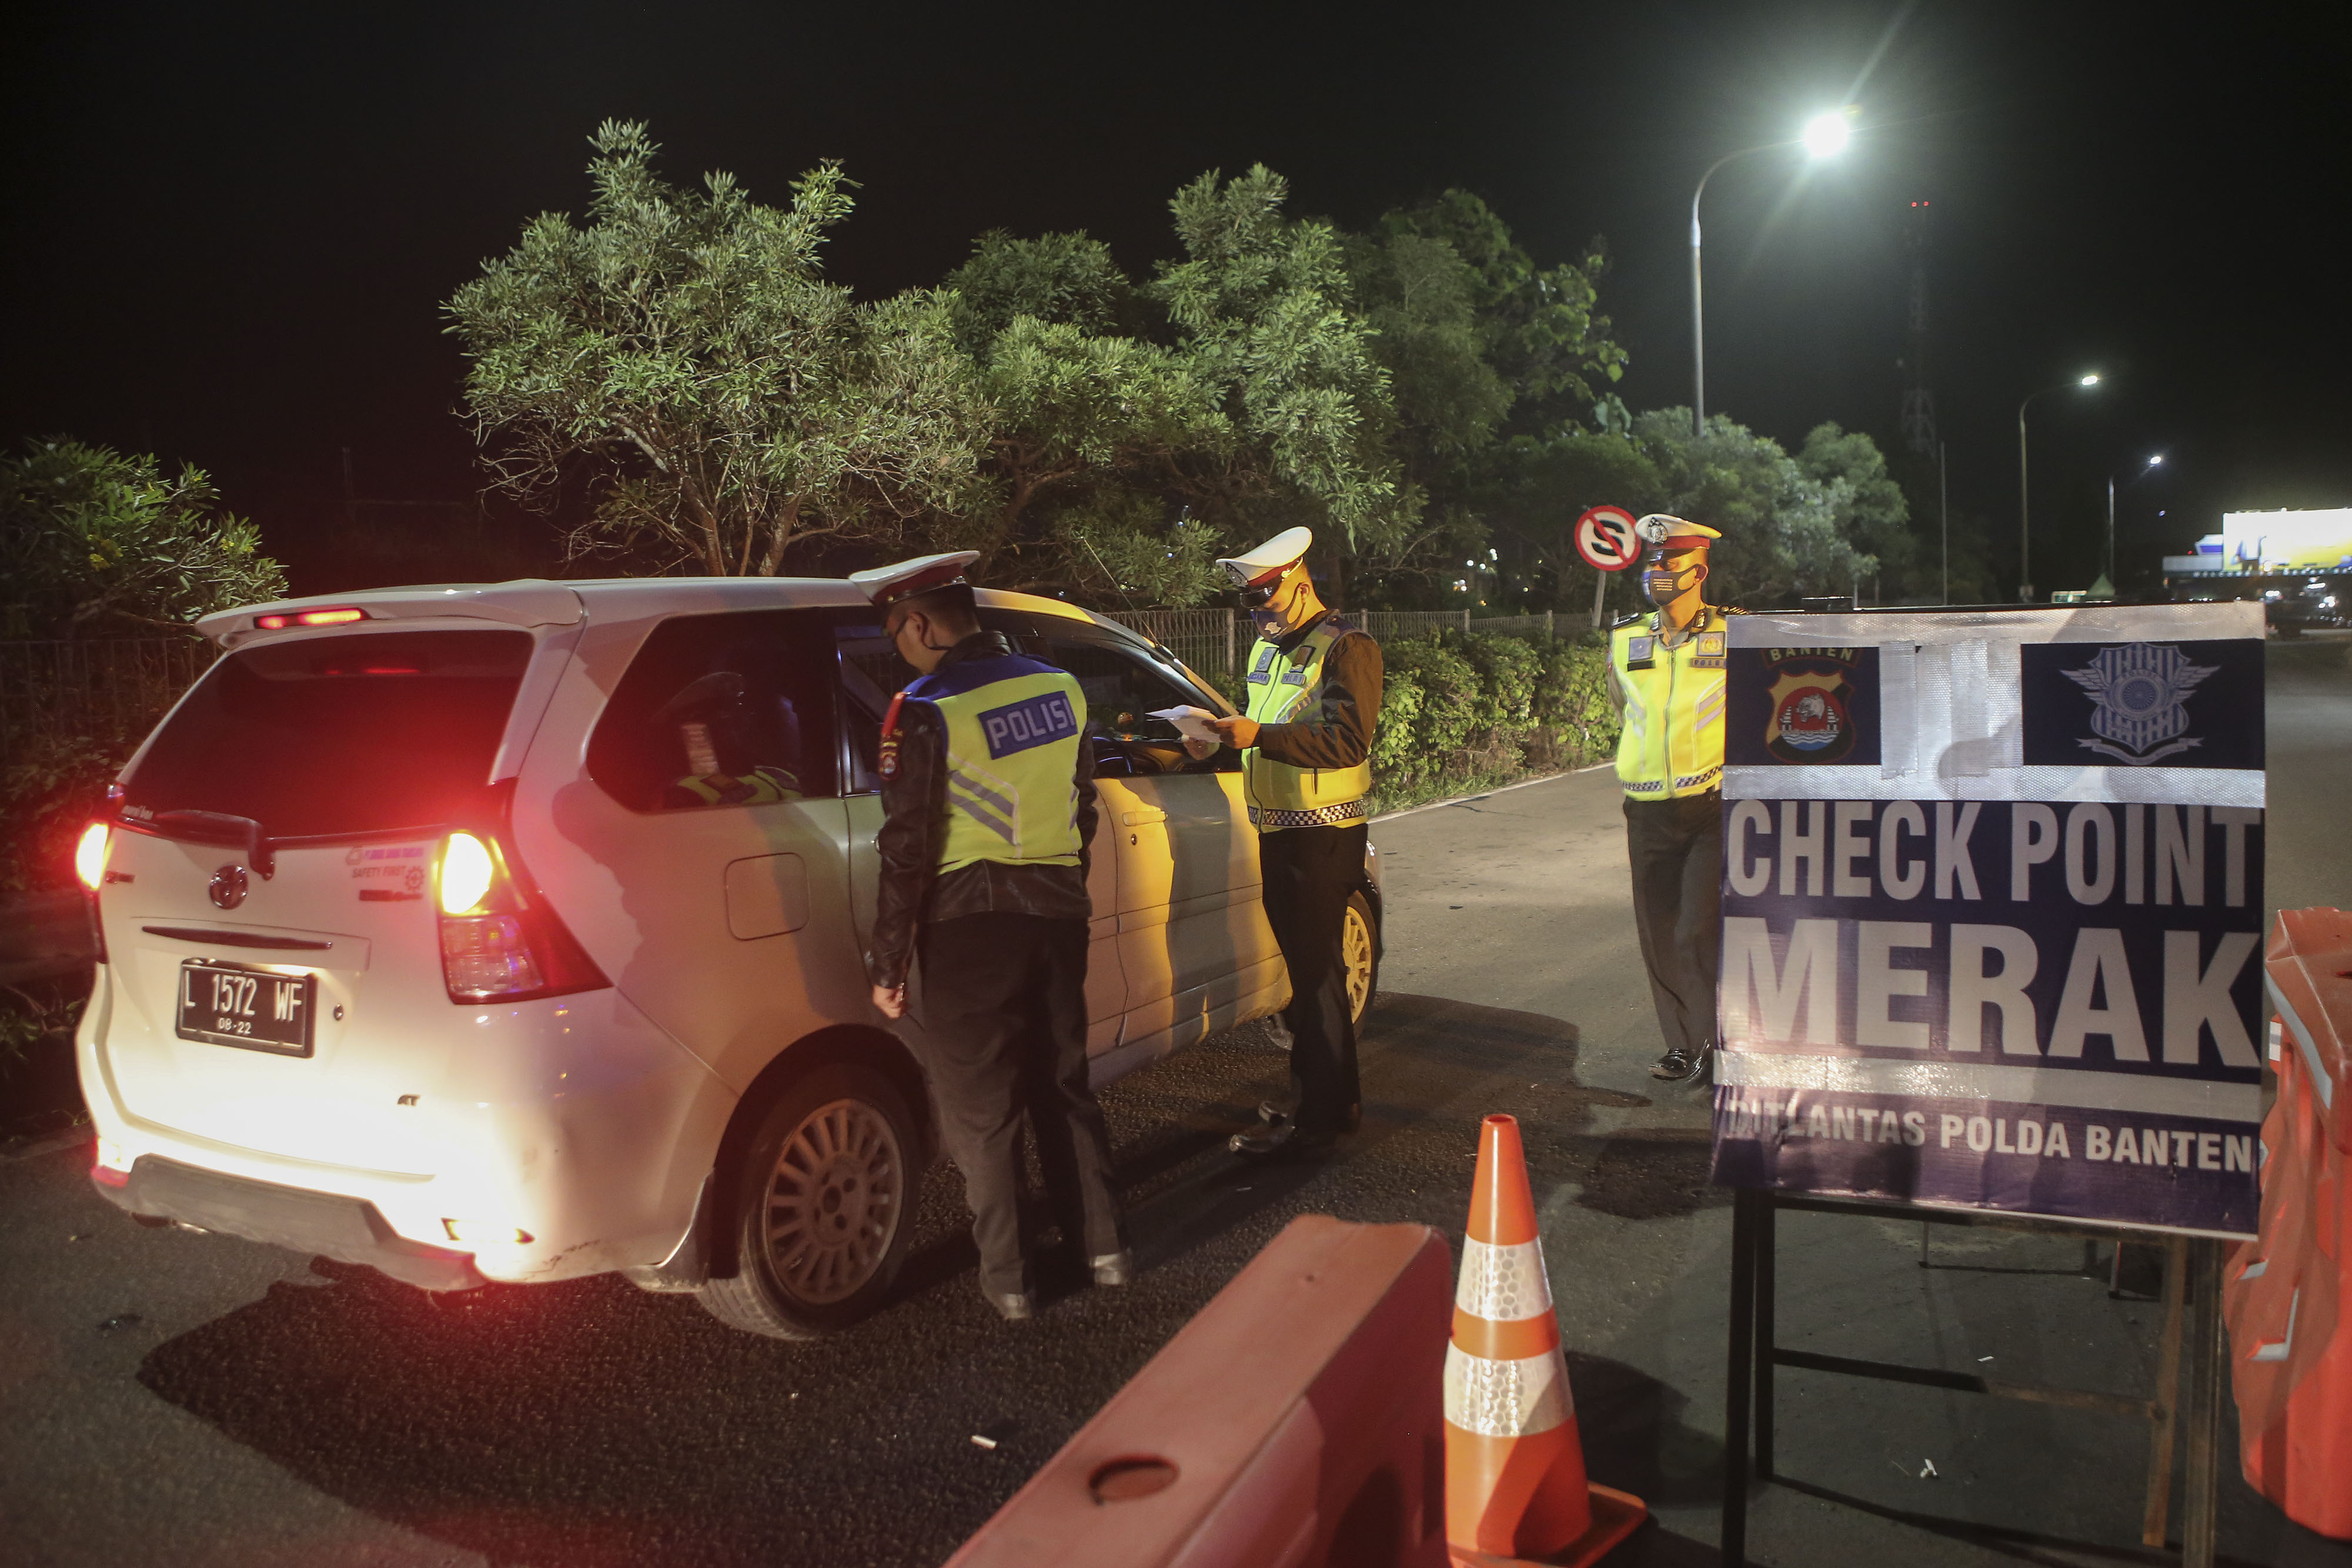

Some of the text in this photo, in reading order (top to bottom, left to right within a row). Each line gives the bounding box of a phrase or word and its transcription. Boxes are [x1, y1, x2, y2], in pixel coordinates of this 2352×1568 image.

[986, 698, 1075, 749] POLISI
[1728, 800, 2261, 907] CHECK POINT
[185, 970, 303, 1022] L 1572 WF
[1720, 916, 2261, 1067] MERAK
[218, 1018, 251, 1034] 08-22
[1940, 1115, 2071, 1158] POLDA
[2086, 1125, 2252, 1172] BANTEN
